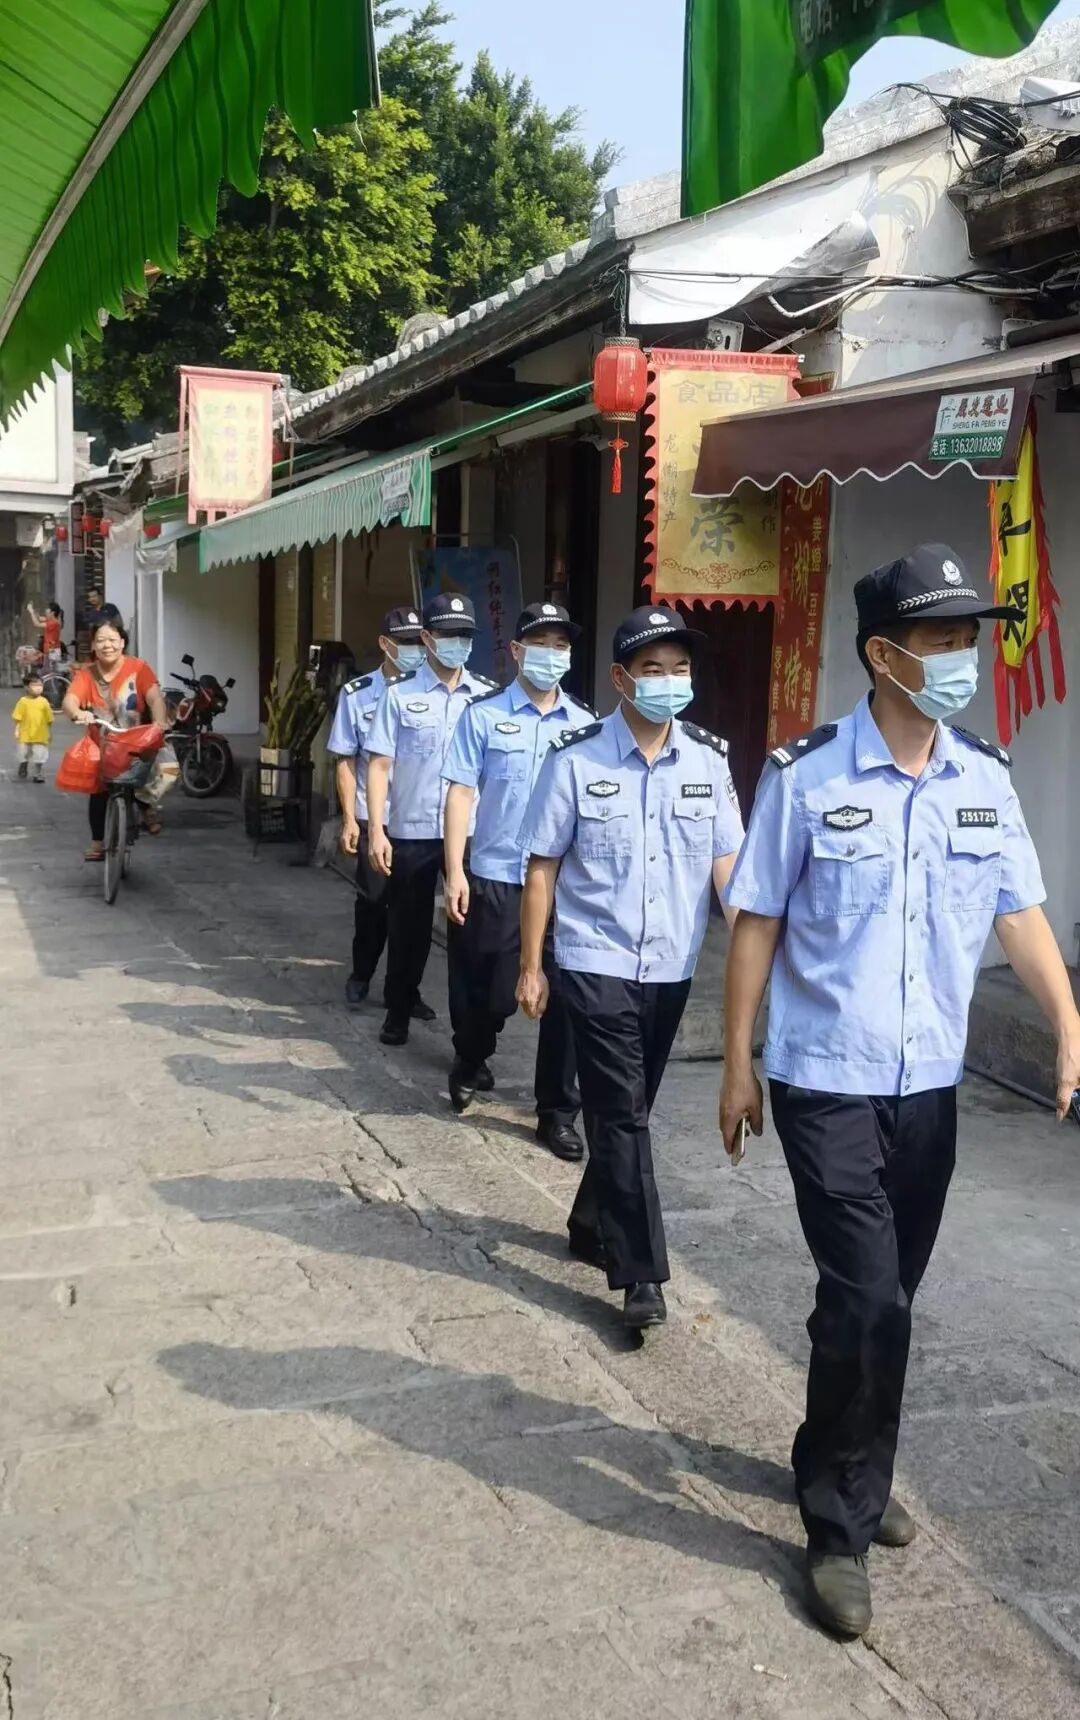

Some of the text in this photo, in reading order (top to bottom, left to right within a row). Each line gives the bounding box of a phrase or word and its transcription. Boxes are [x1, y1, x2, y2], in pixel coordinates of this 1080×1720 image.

[671, 376, 777, 407] 食品店
[971, 420, 980, 429] FA
[981, 419, 996, 428] PENG
[998, 418, 1008, 427] YE
[661, 433, 680, 532] 龙湖特产
[961, 811, 996, 822] 251725
